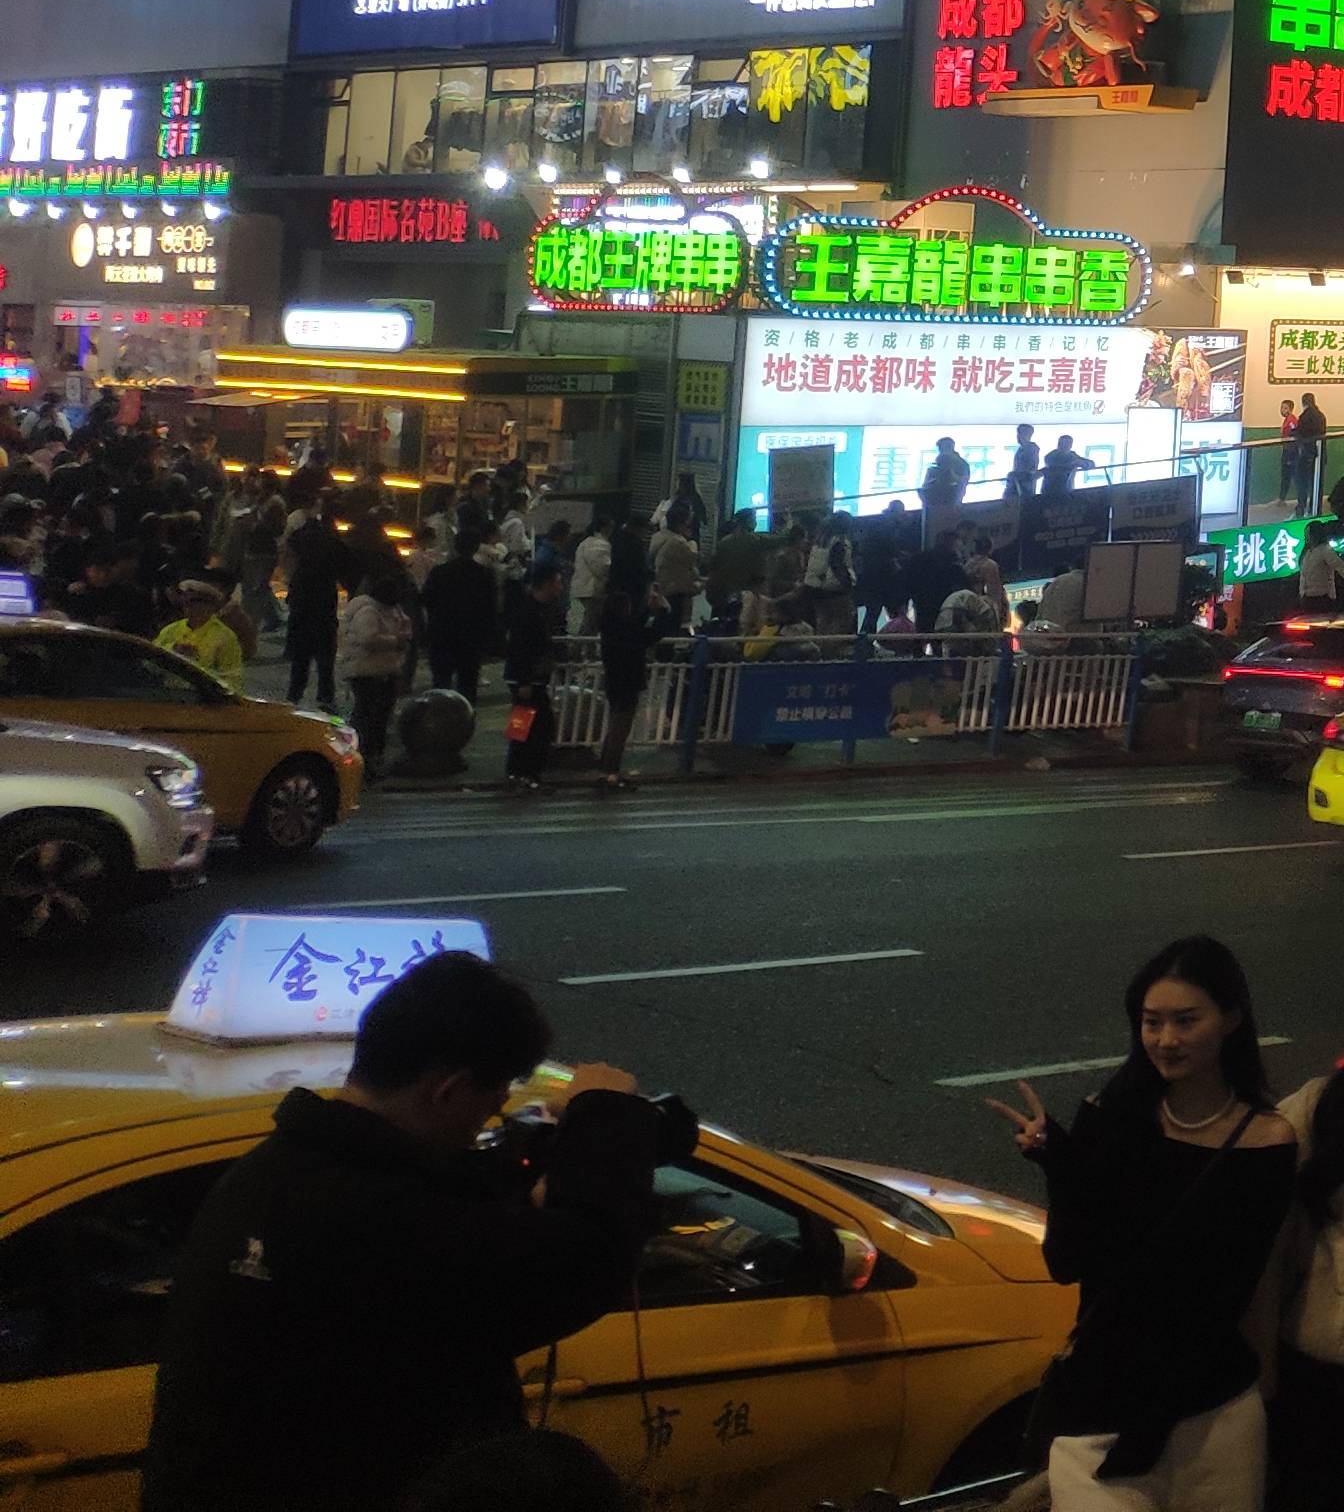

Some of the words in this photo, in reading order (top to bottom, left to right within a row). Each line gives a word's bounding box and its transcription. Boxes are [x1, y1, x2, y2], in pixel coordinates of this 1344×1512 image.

[0, 87, 133, 163] 好吃街
[330, 199, 468, 243] 红鼎国际名苑B座
[534, 224, 739, 296] 成都王牌串串
[792, 232, 1130, 312] 王嘉龍串串香
[762, 351, 937, 395] 地道成都味
